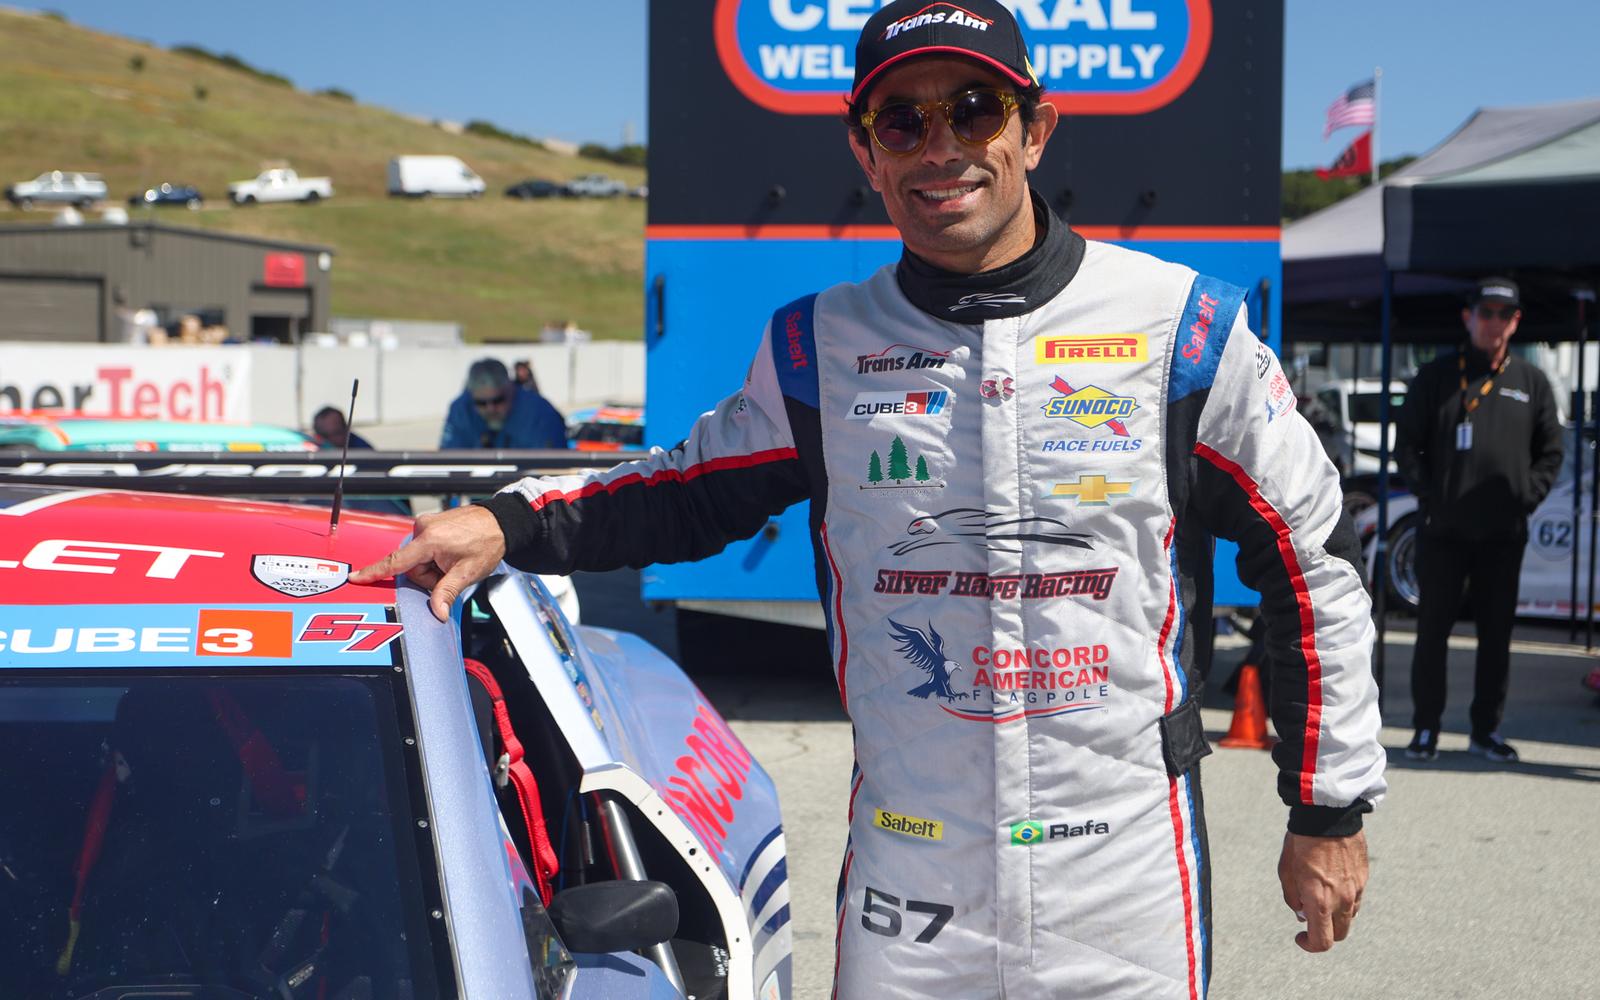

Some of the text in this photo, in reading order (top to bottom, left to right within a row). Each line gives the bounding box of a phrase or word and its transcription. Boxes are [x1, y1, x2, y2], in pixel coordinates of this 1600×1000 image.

[885, 10, 988, 41] Trans Am
[786, 310, 808, 369] Sabelt
[1182, 293, 1219, 364] Sabelt
[1045, 338, 1138, 358] PIRELLI
[857, 352, 946, 374] Trans Am
[1048, 399, 1133, 415] SUNOCO
[1042, 439, 1142, 452] RACE FUELS
[1538, 521, 1571, 548] 62
[873, 566, 1119, 600] Silver Hare Racing
[295, 613, 403, 652] 57
[972, 643, 1109, 669] CONCORD
[972, 665, 1109, 690] AMERICAN
[972, 685, 1109, 704] FLAGPOLE
[880, 811, 936, 838] Sabelt
[1049, 819, 1110, 839] Rafa
[861, 886, 954, 944] 57
